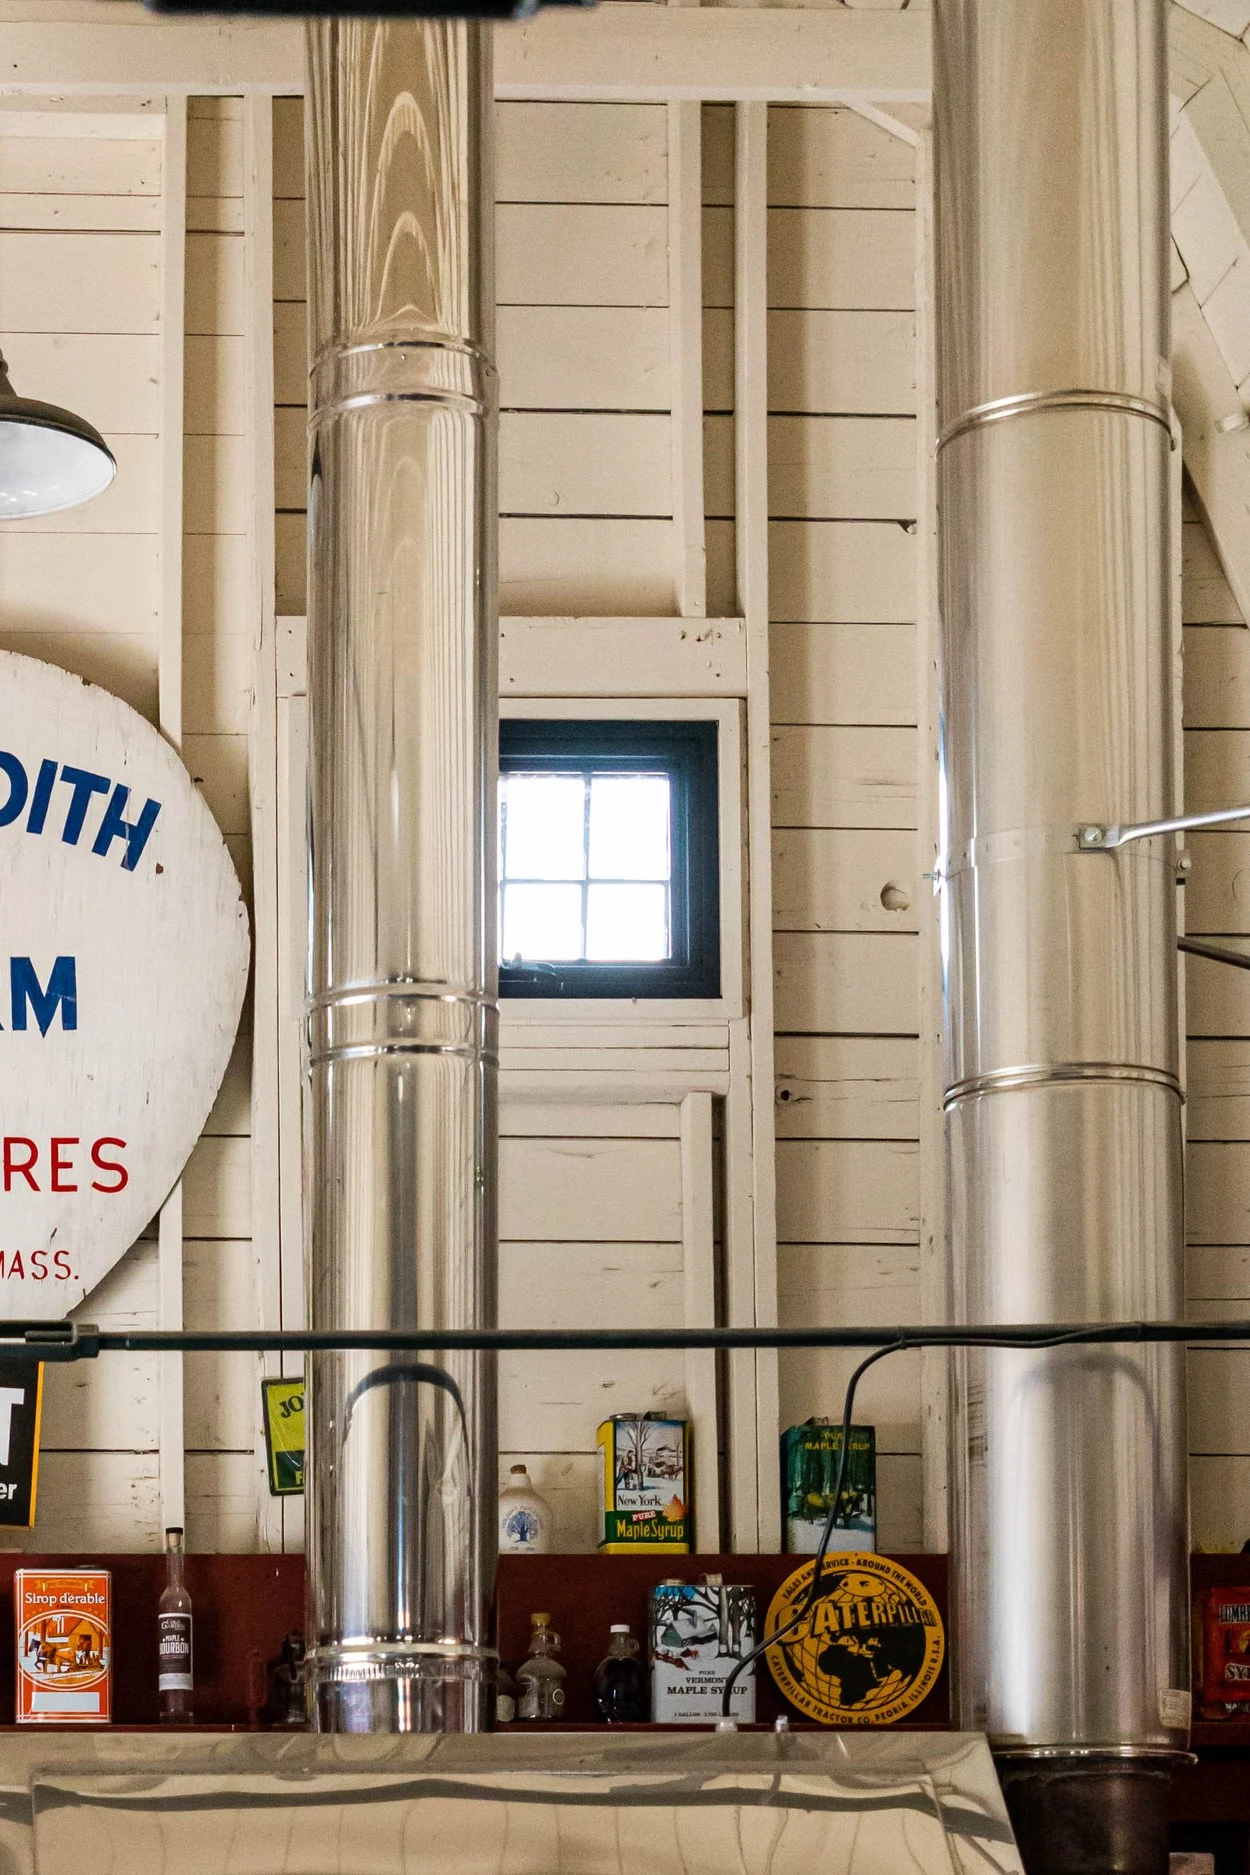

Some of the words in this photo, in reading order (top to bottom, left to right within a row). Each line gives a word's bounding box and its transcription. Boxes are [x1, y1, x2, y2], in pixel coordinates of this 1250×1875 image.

[617, 1494, 638, 1506] New
[638, 1494, 662, 1506] York
[616, 1519, 650, 1539] Maple
[651, 1519, 684, 1540] Syrup
[856, 1558, 892, 1575] AROUND
[904, 1581, 927, 1607] WORLD
[25, 1592, 57, 1607] Sirop
[775, 1601, 938, 1643] CATERPILLAR
[667, 1686, 707, 1694] MAPLE
[711, 1686, 748, 1694] SYUP
[771, 1655, 810, 1711] CATERPILLAR
[811, 1705, 853, 1724] TRACTOR
[910, 1665, 936, 1702] ILLINOIS
